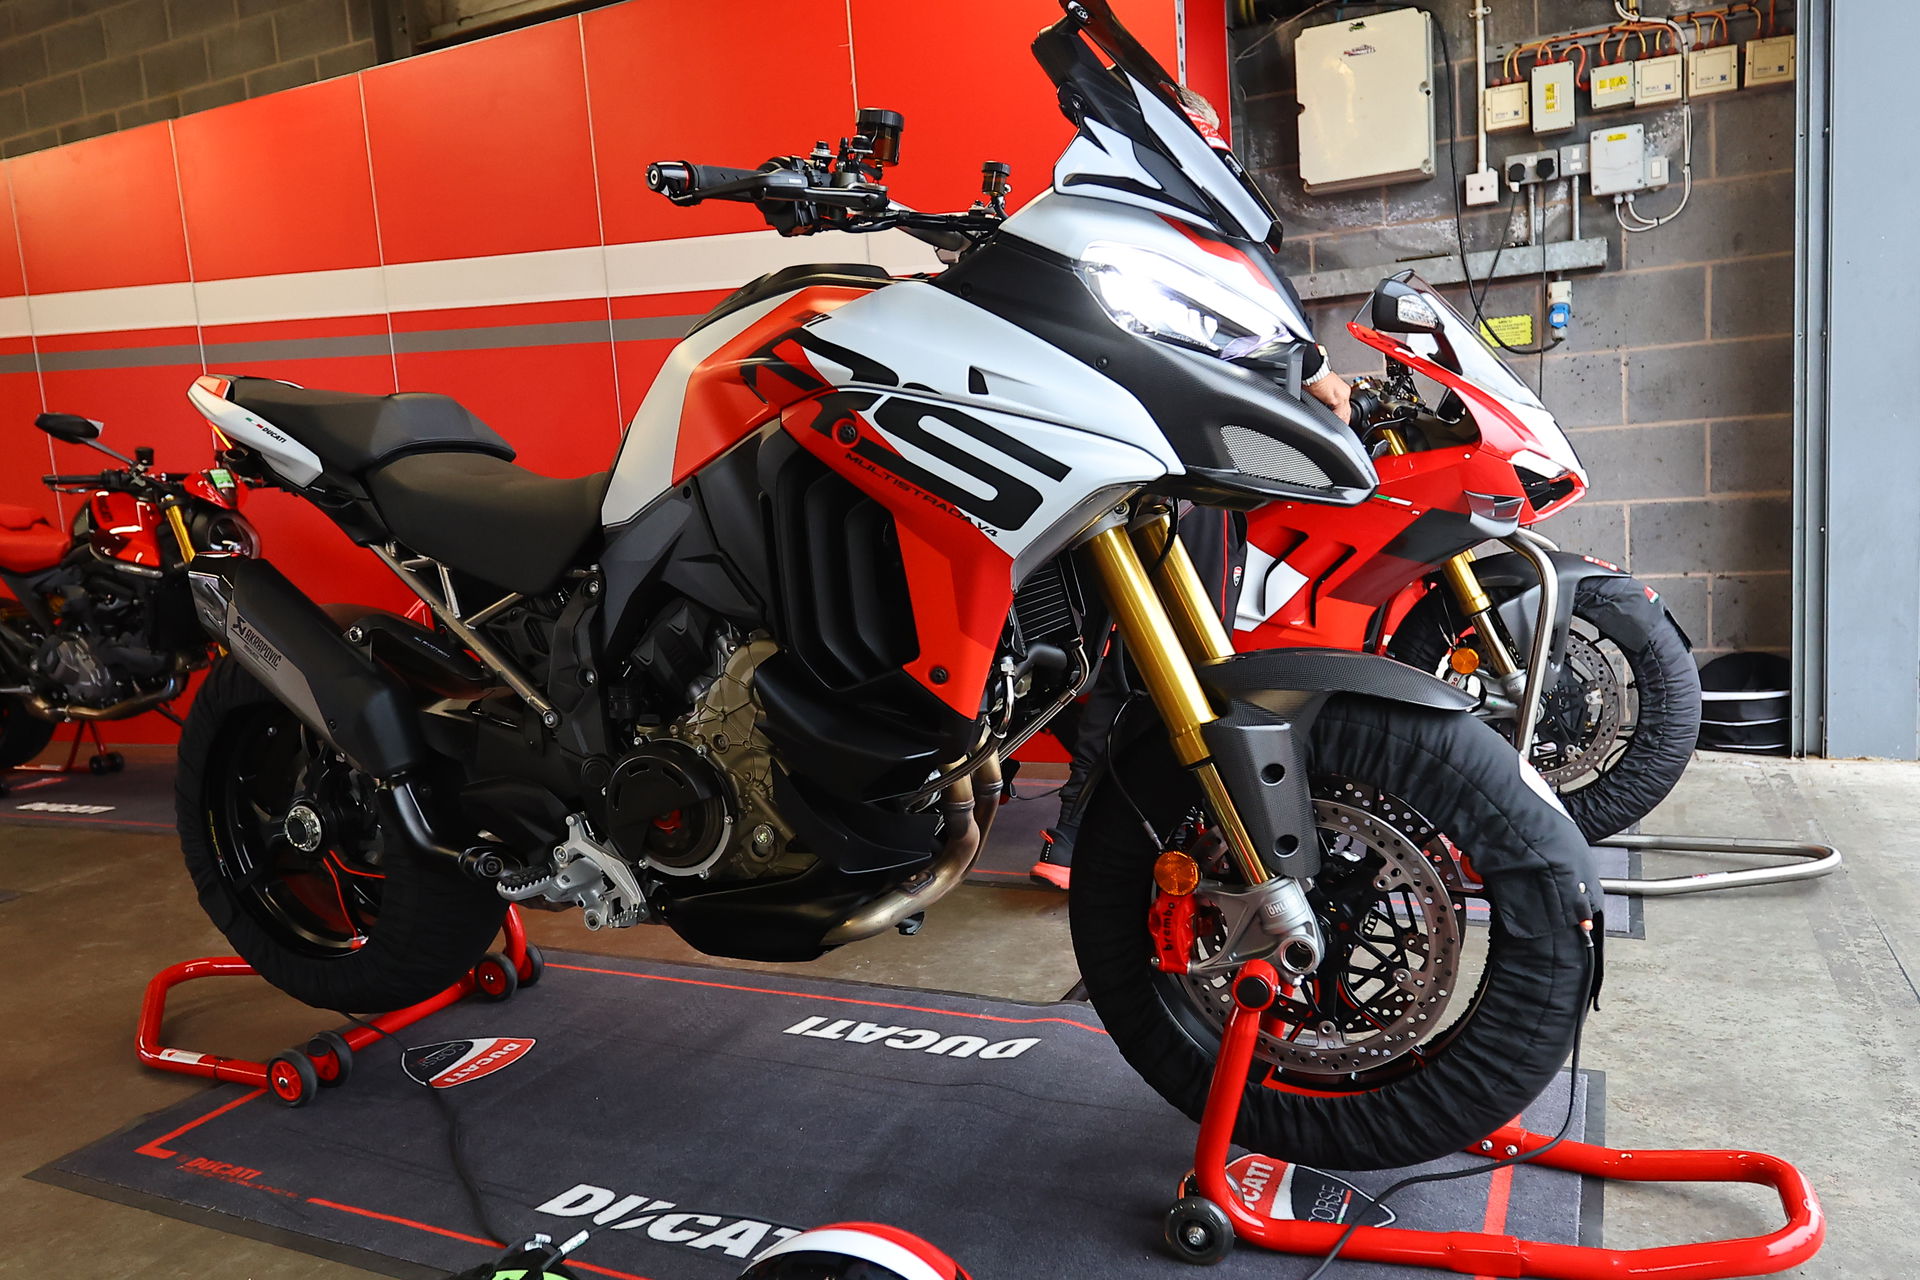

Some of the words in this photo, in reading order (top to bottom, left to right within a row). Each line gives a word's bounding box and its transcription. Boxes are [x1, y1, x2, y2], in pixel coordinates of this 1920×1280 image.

[262, 427, 287, 444] DUCATI
[844, 452, 973, 525] MULTISTRADA
[976, 521, 999, 538] V4
[1162, 902, 1175, 951] brembo
[782, 1015, 1042, 1060] DUCATI
[443, 1042, 522, 1083] DUCATI
[183, 1156, 264, 1181] DUCATI
